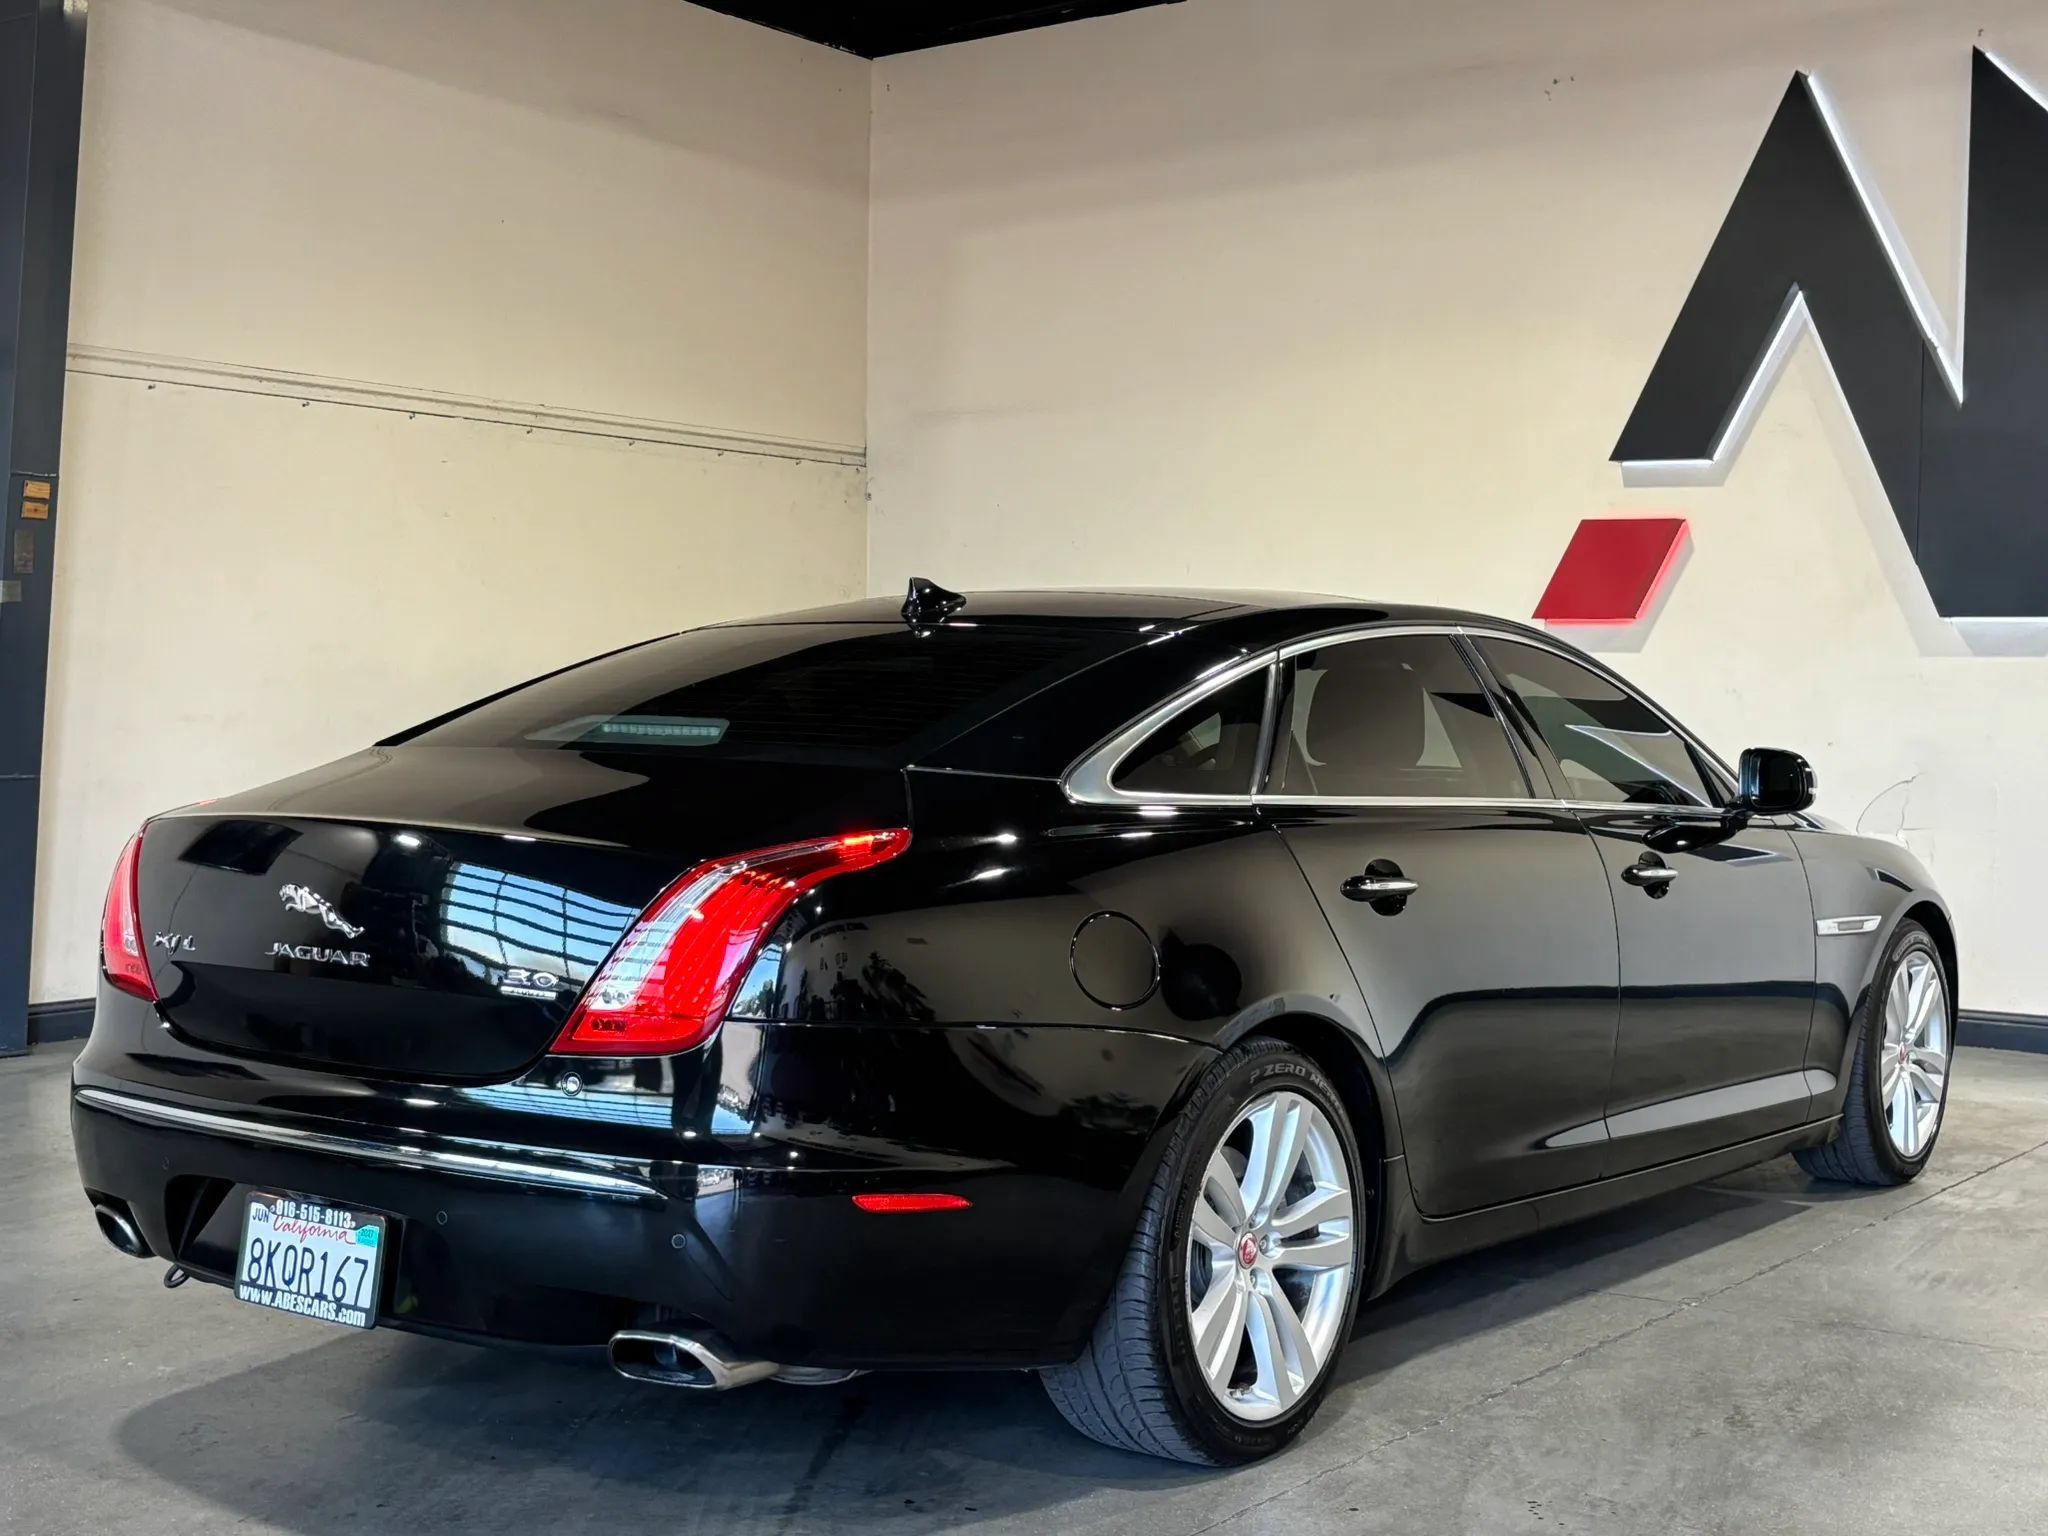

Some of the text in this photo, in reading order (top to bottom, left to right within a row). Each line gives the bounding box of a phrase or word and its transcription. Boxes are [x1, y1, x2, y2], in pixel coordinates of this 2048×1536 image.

[264, 942, 370, 967] JAGUAR
[1263, 1063, 1306, 1077] ZERO
[252, 1207, 269, 1223] JUN
[273, 1215, 356, 1244] California
[248, 1237, 369, 1308] 8KQR167
[239, 1284, 366, 1328] www.ABESCARS.com
